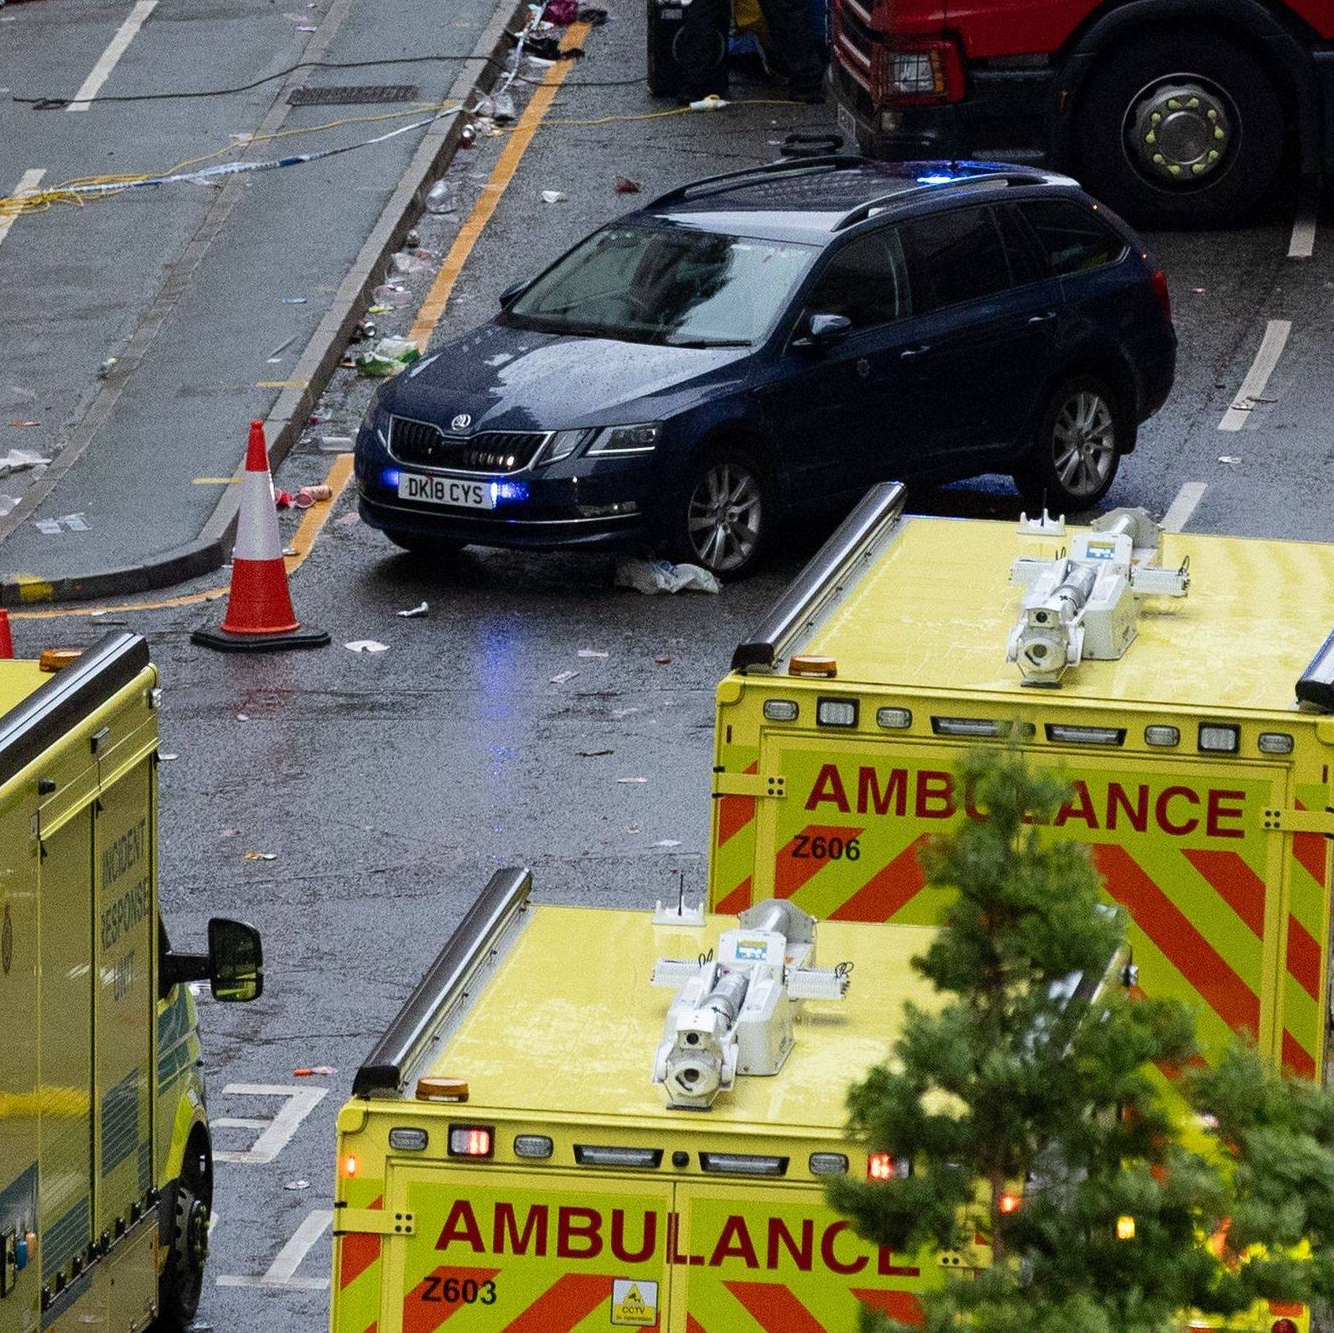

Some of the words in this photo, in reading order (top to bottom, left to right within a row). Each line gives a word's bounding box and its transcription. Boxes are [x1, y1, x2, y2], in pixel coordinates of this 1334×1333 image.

[408, 477, 445, 501] DK18
[450, 483, 483, 505] CYS
[791, 834, 861, 861] Z606
[421, 1276, 497, 1305] Z603
[622, 1306, 645, 1314] CCTV
